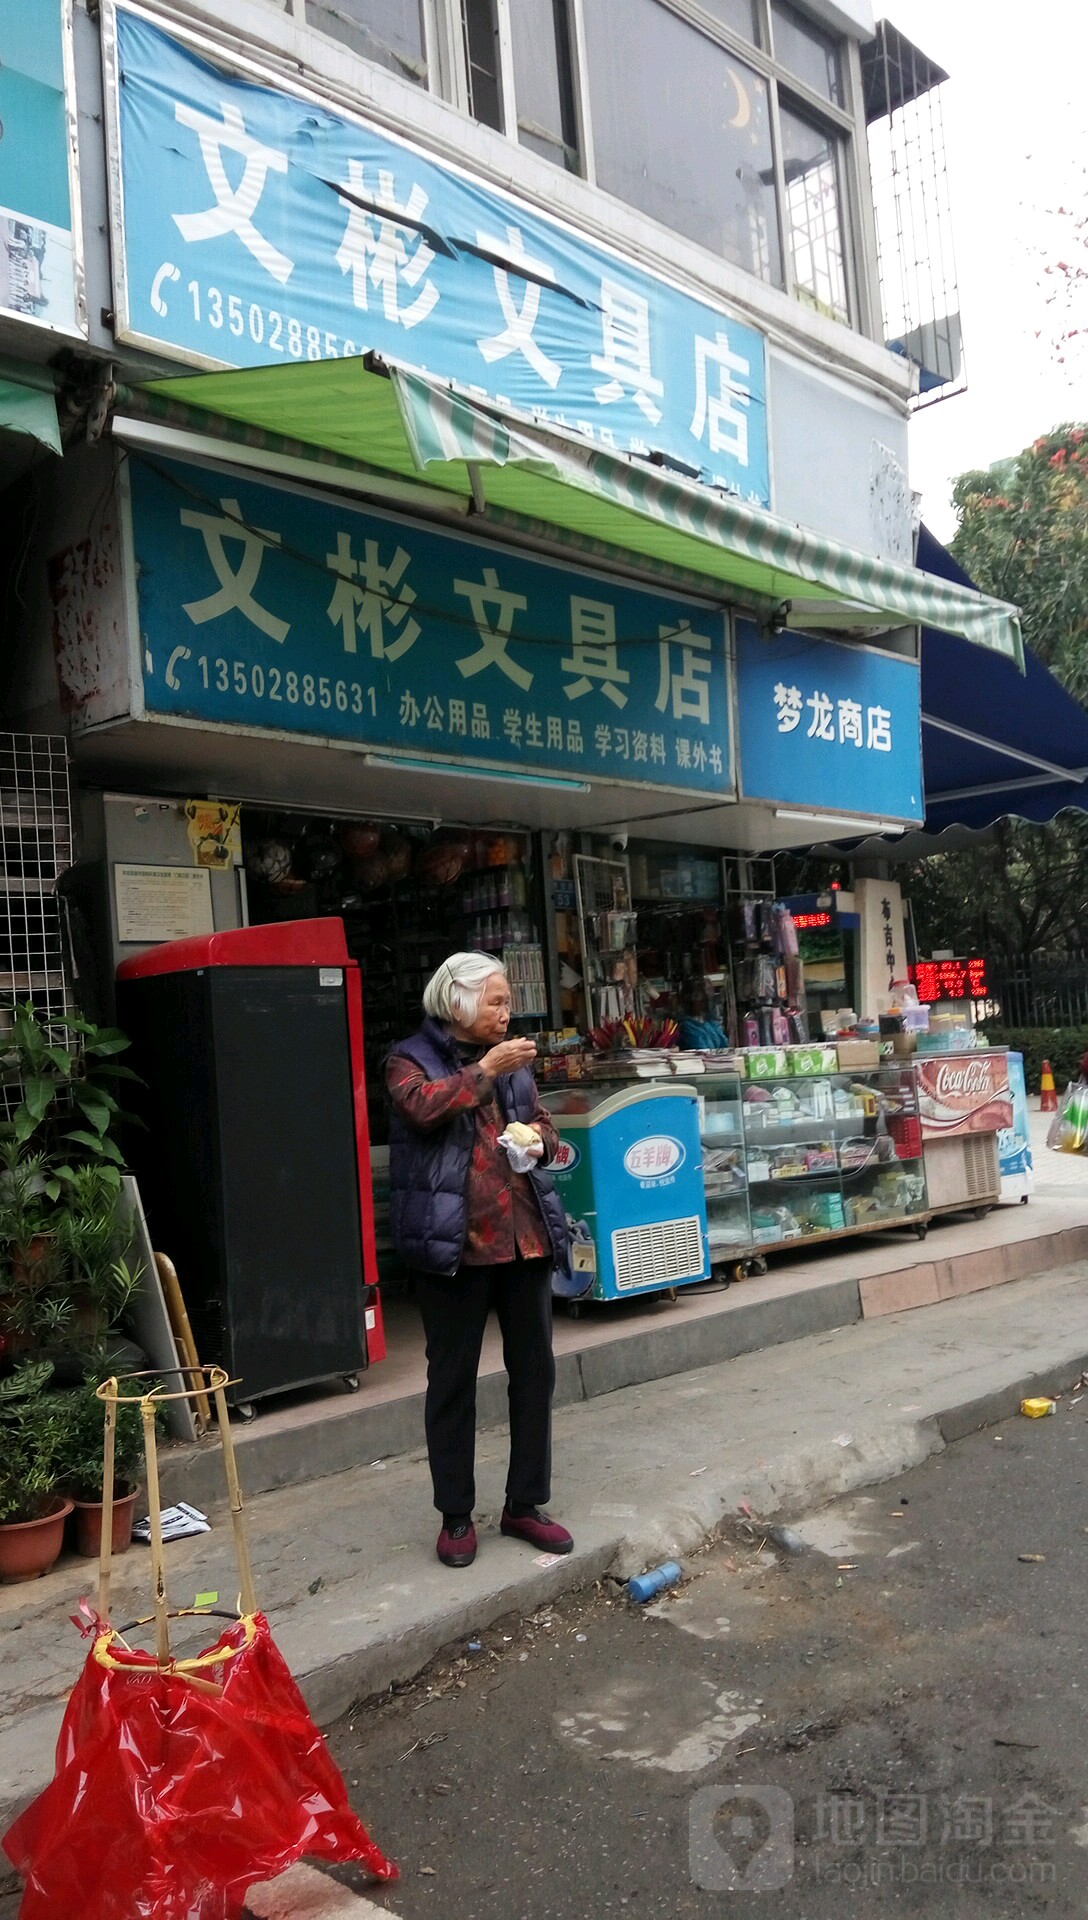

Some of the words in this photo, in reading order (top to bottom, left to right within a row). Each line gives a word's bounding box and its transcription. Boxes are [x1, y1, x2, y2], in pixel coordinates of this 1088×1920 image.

[172, 101, 750, 467] 文彬文具店
[180, 498, 712, 725] 文彬文具店
[198, 655, 377, 717] 13502885631
[773, 682, 892, 752] 梦龙商店
[399, 689, 490, 739] 办公用品
[503, 707, 584, 754] 学生用品
[594, 723, 667, 766] 学习资料
[675, 737, 723, 775] 课外书
[630, 1143, 673, 1169] 五羊牌
